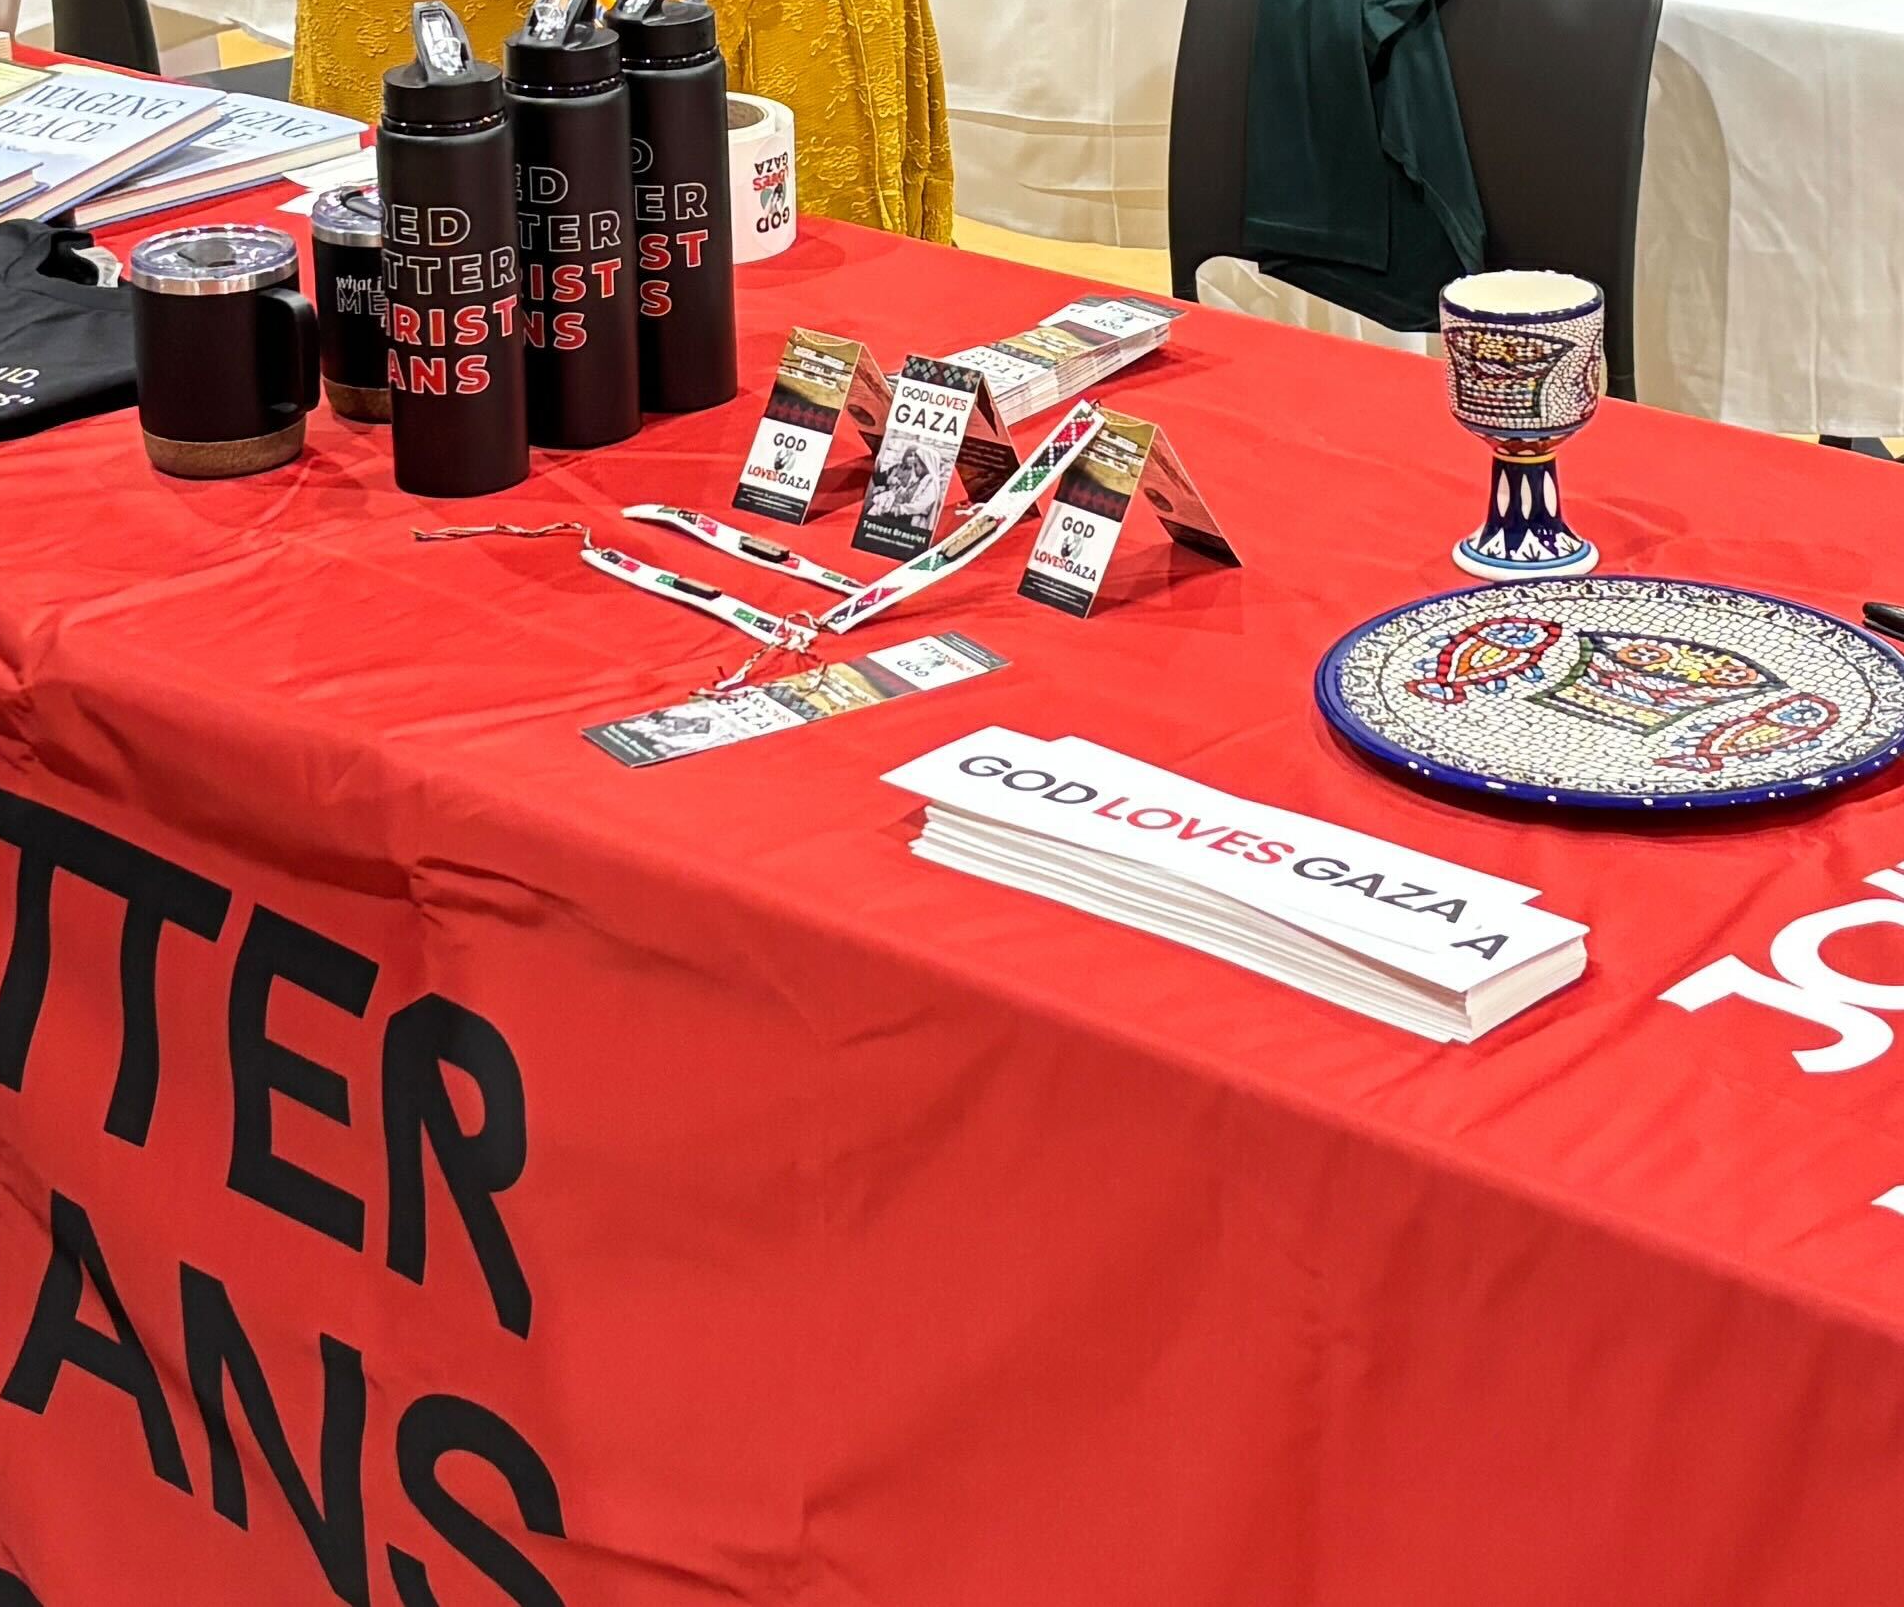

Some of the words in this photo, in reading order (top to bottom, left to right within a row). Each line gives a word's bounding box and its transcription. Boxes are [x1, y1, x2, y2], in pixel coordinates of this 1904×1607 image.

[18, 82, 187, 122] WAGING
[216, 100, 328, 140] AGING
[752, 165, 790, 192] LOVES
[753, 151, 789, 177] GAZA
[518, 210, 621, 253] TER
[756, 206, 791, 234] GOD
[335, 273, 373, 292] what
[383, 245, 517, 296] TTER
[522, 258, 622, 301] IST
[385, 294, 518, 348] RIST
[523, 311, 588, 351] NS
[387, 349, 491, 396] ANS
[900, 385, 930, 404] GOD
[928, 391, 969, 413] LOVES
[894, 403, 960, 438] GAZA
[773, 431, 809, 453] GOD
[1061, 516, 1096, 540] GOD
[957, 753, 1098, 806] GOD
[1091, 795, 1299, 867] LOVES
[1291, 855, 1470, 925] GAZA
